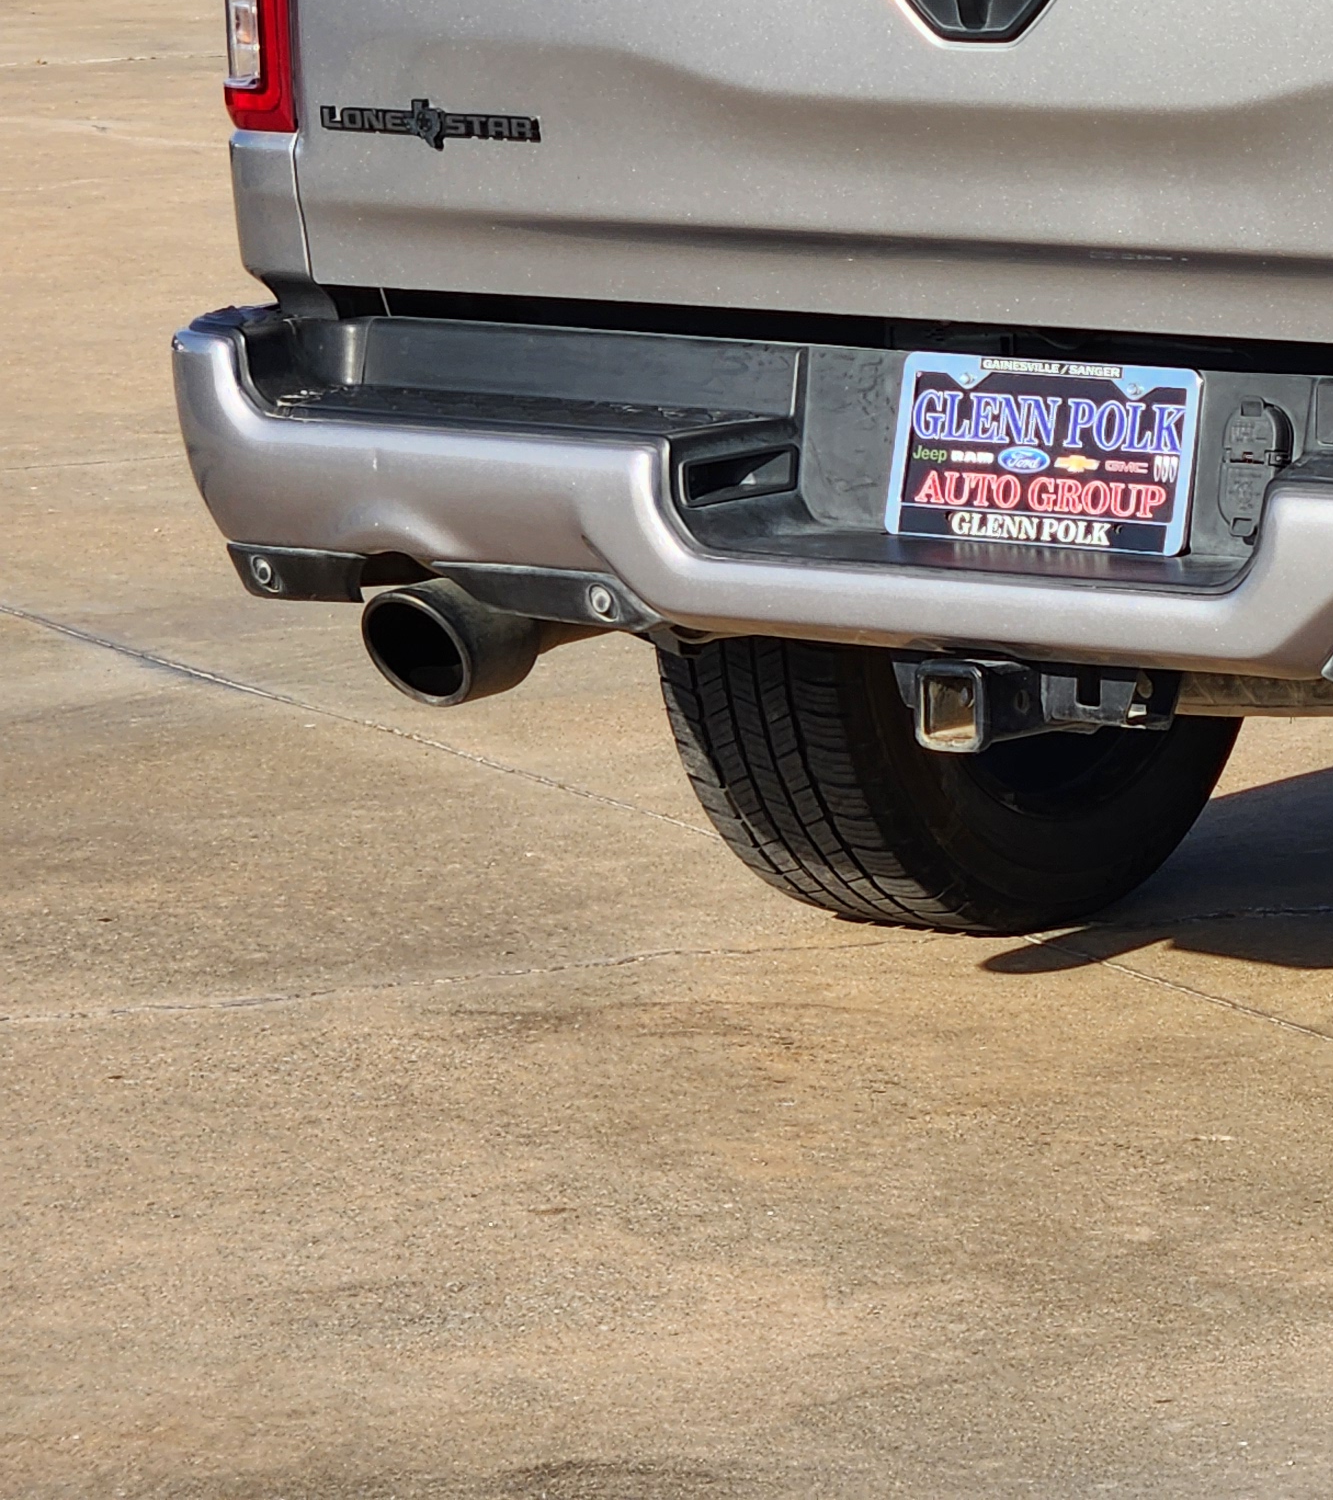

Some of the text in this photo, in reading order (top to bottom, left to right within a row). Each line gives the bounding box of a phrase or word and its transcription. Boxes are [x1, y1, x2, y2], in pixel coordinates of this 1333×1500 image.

[320, 105, 542, 143] LONE STAR
[912, 388, 1187, 455] GLENN POLK
[912, 444, 1149, 474] Jeep RAM Ford GMC
[914, 470, 1167, 519] AUTO GROUP
[951, 511, 1111, 547] GLENN POLK
